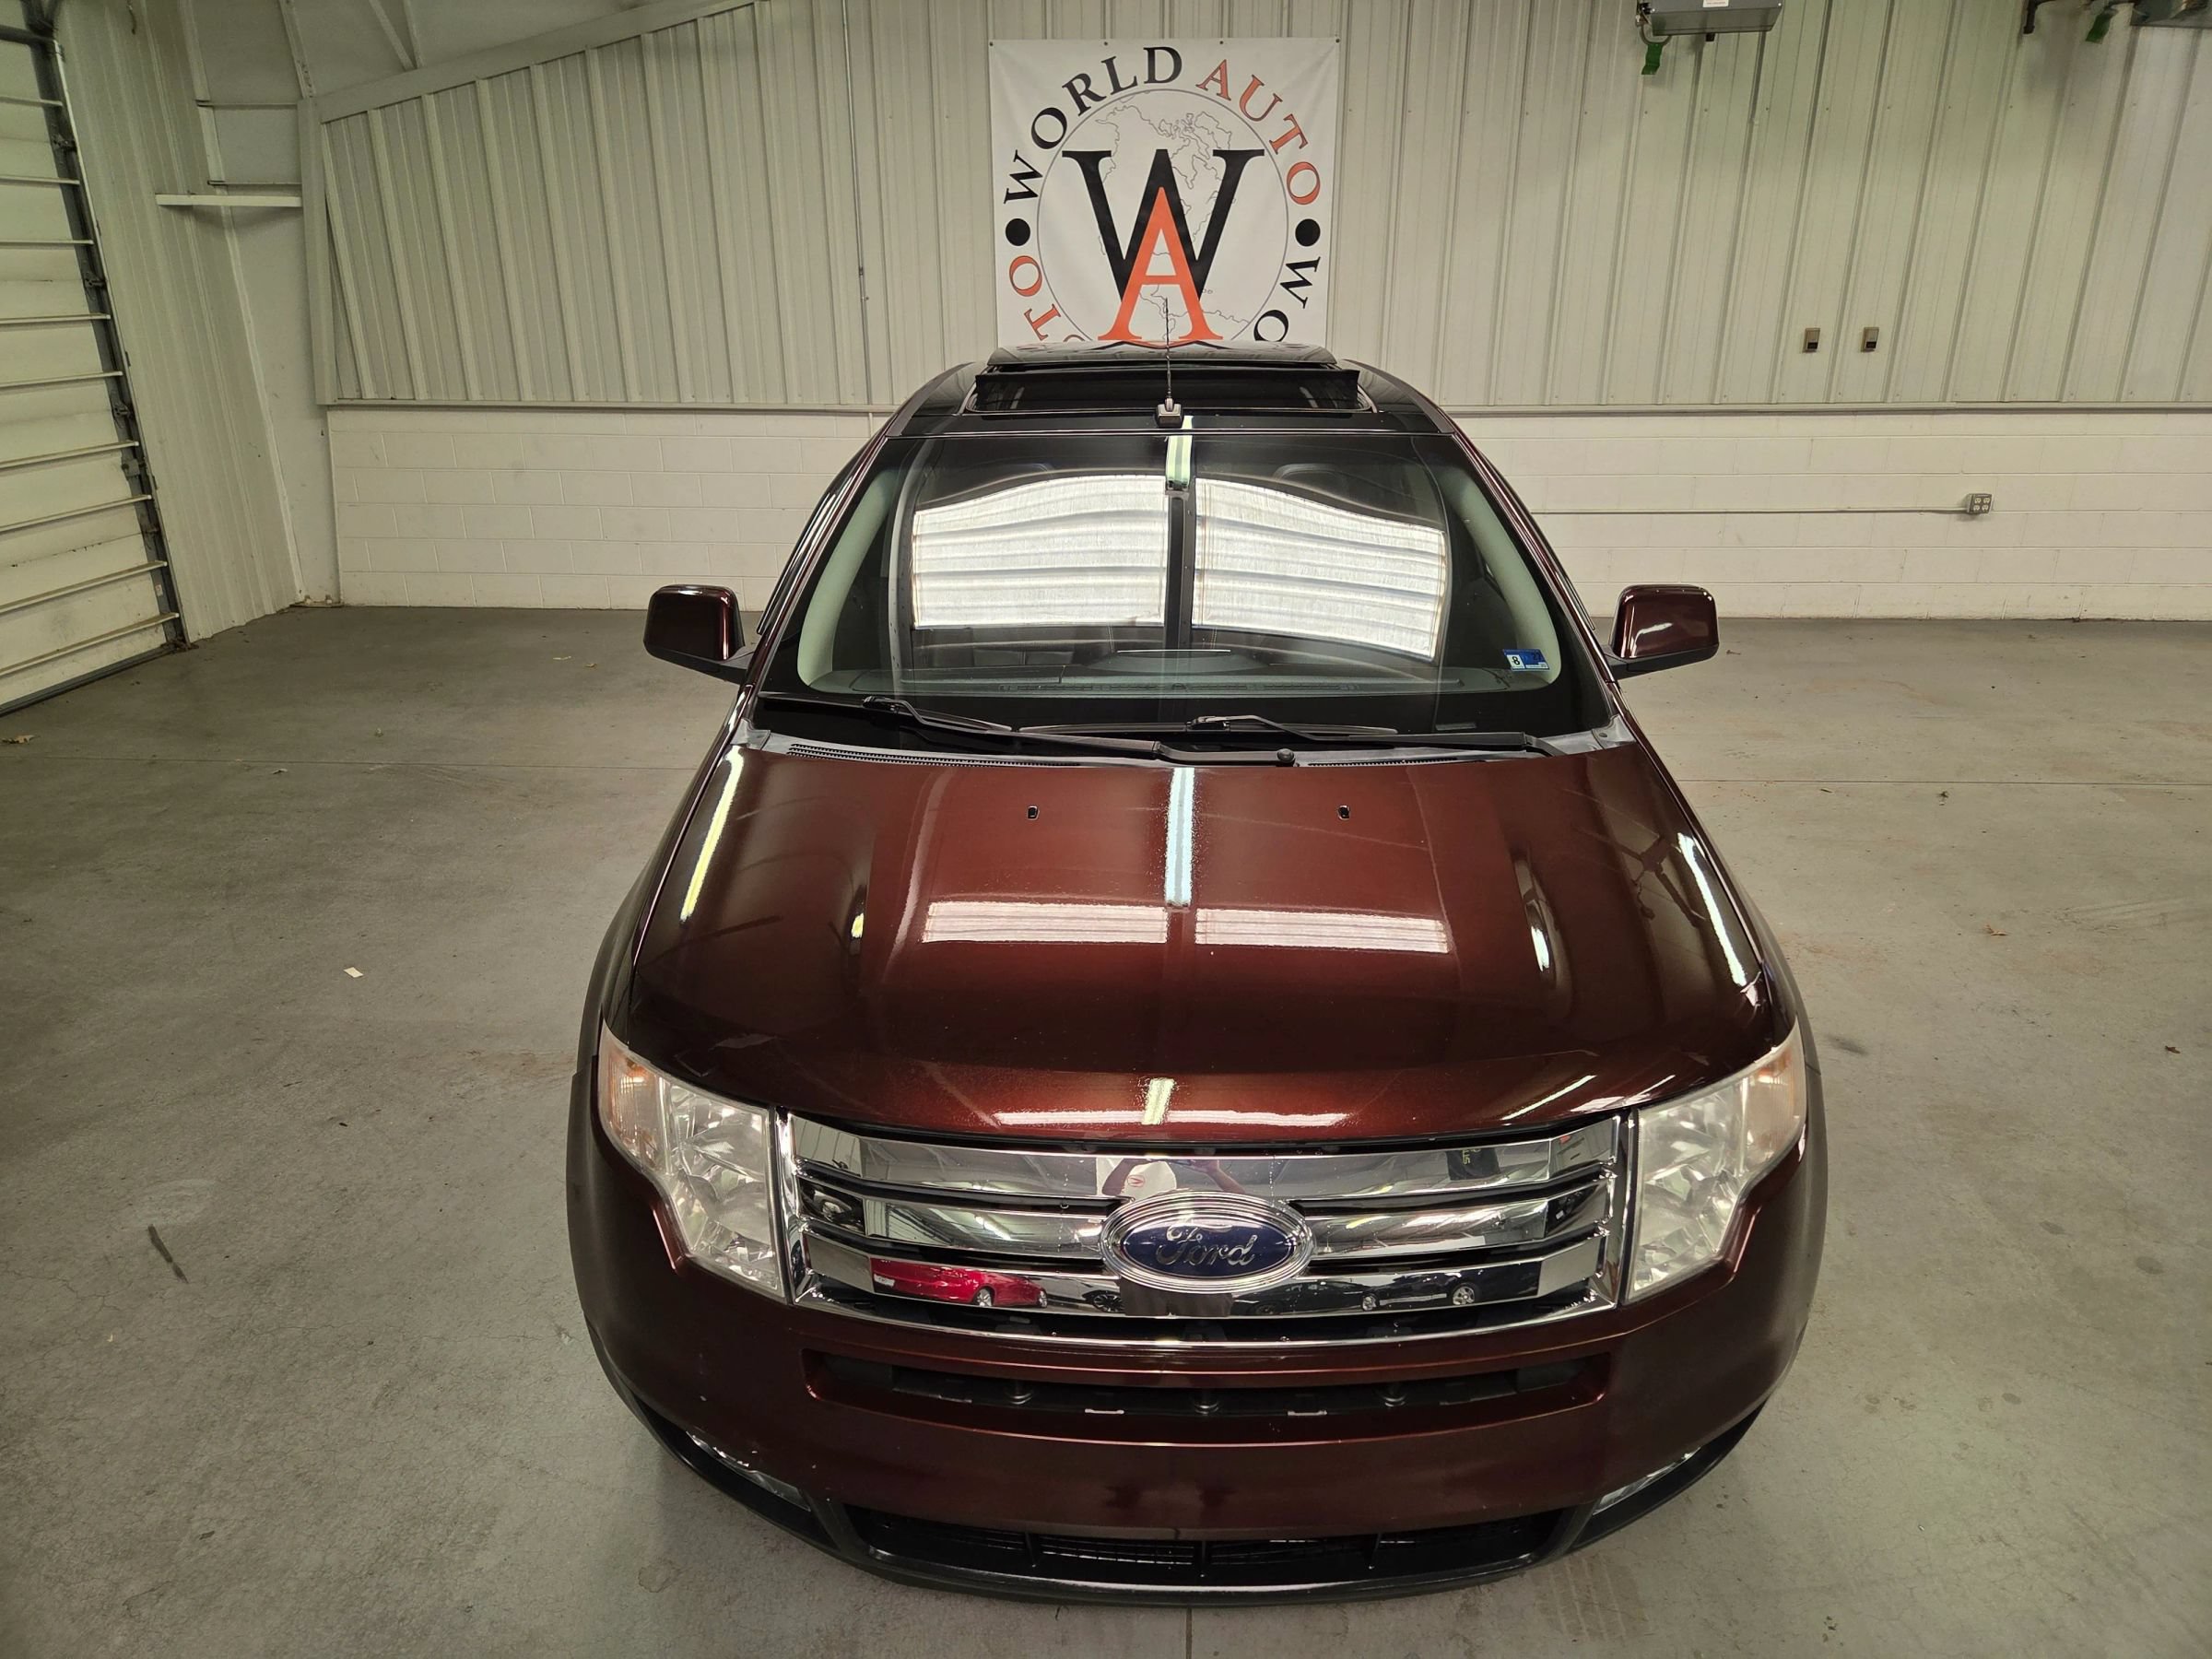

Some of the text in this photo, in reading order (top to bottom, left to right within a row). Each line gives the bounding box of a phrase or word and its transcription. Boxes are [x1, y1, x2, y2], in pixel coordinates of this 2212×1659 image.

[1004, 46, 1321, 205] WORLD AUTO
[1009, 255, 1085, 341] TO
[1512, 655, 1521, 665] 8
[1157, 1224, 1258, 1266] Ford
